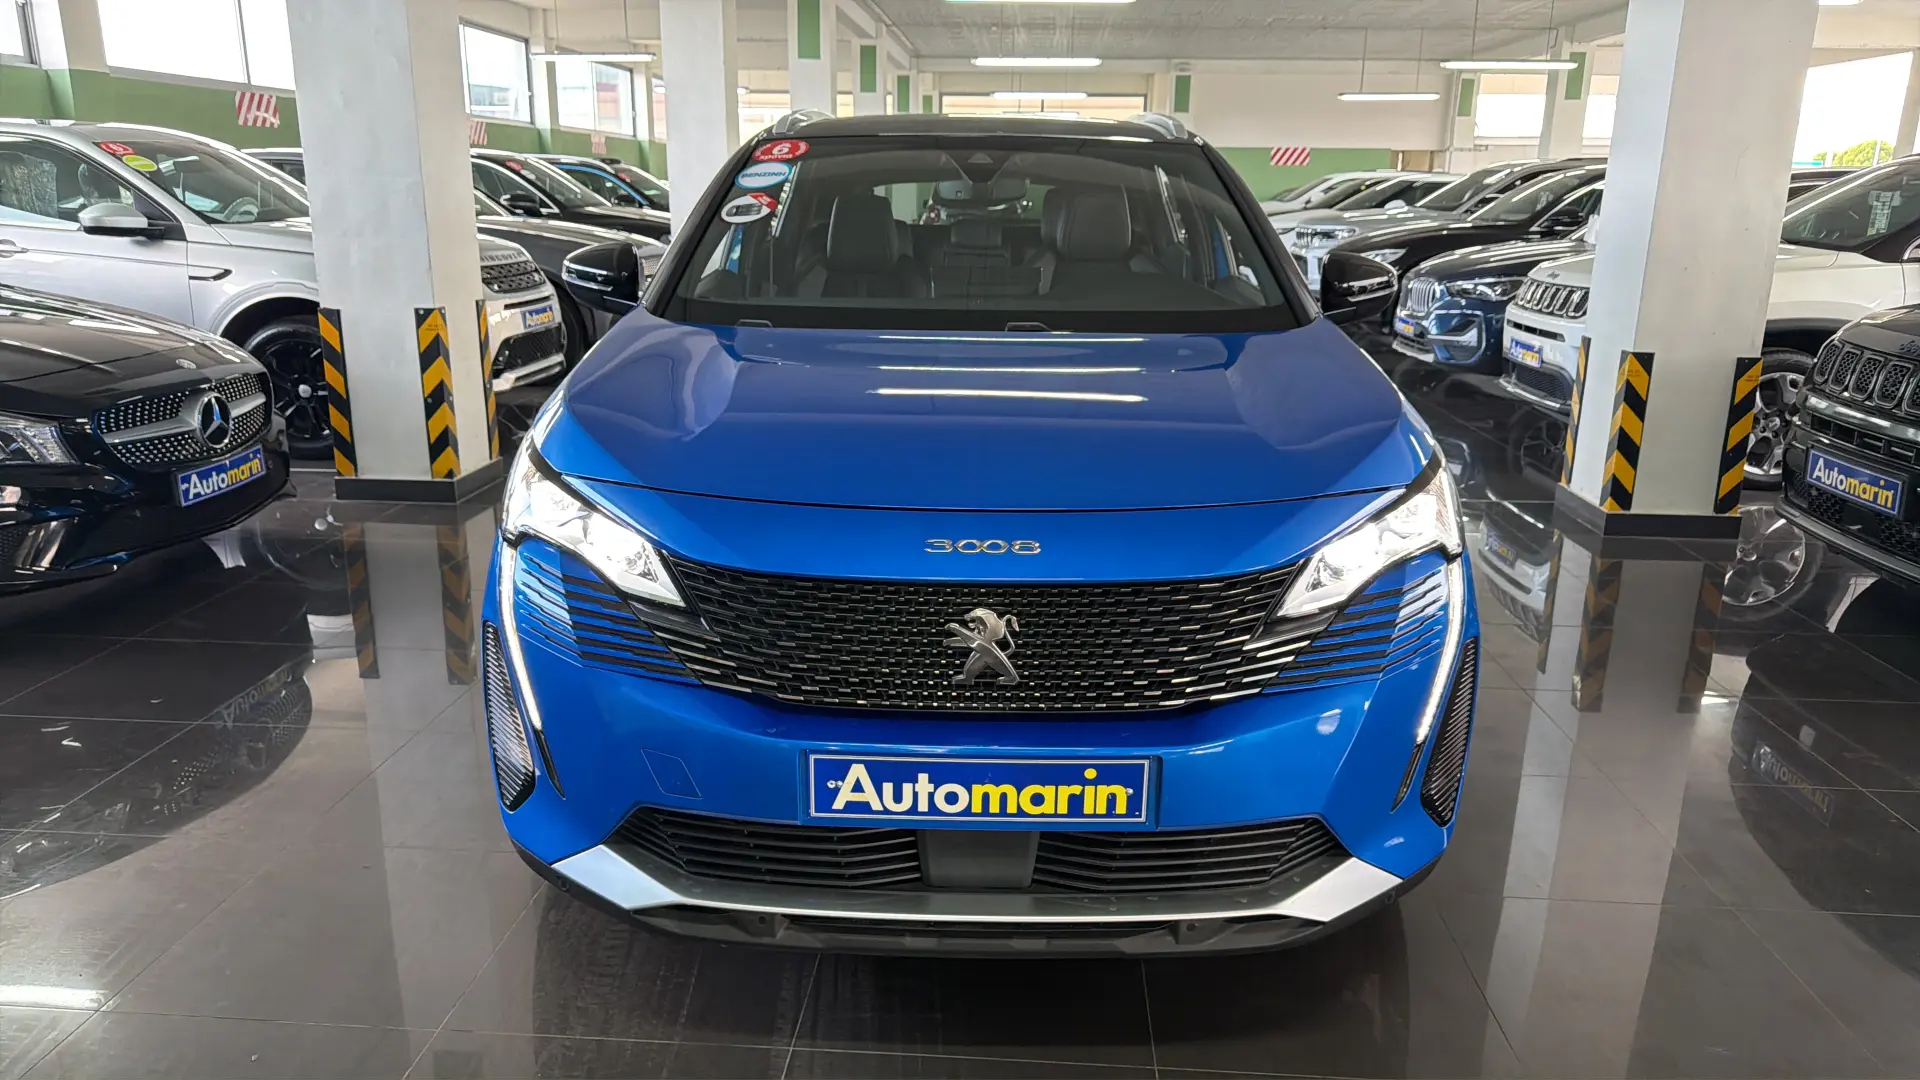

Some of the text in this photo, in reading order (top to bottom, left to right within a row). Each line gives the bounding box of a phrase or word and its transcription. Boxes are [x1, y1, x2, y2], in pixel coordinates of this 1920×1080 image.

[772, 142, 791, 155] 6
[188, 453, 262, 500] Automarin
[1812, 457, 1894, 508] Automarin
[924, 538, 1042, 555] 3008
[831, 763, 1128, 815] Automarin
